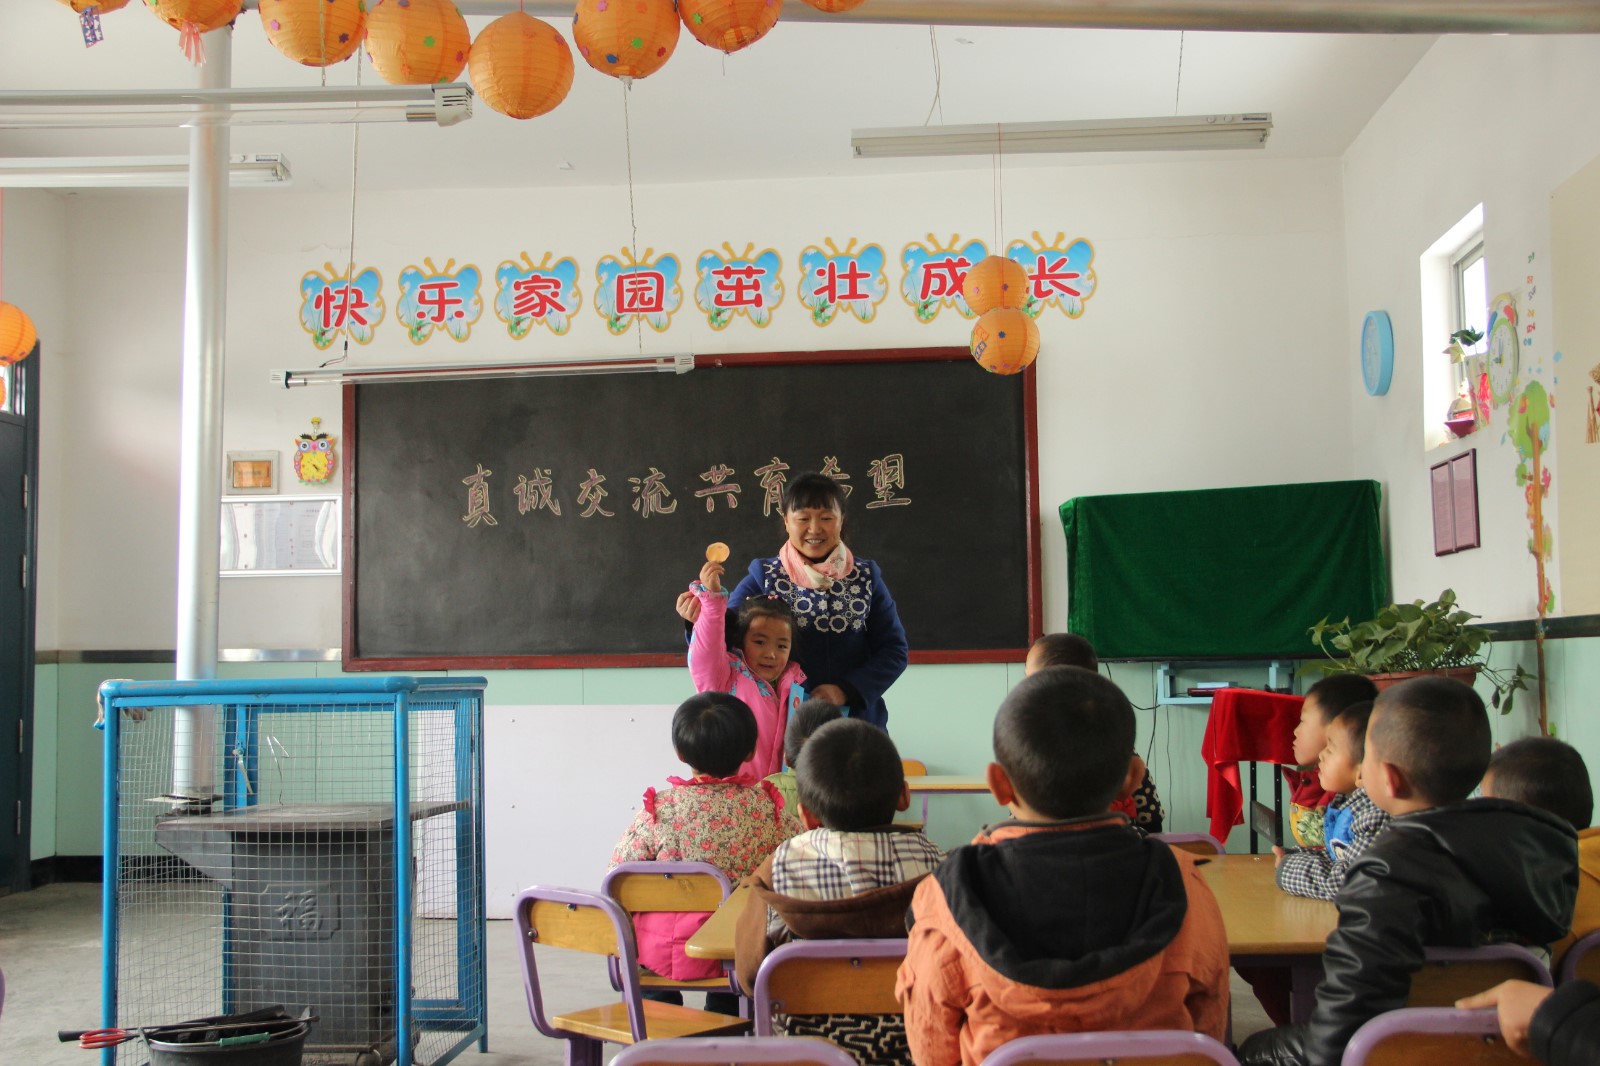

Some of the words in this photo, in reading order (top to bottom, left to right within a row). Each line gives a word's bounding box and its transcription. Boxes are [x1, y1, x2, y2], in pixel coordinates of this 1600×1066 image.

[315, 255, 1079, 329] 快乐家园茁壮成长
[274, 889, 324, 935] 福
